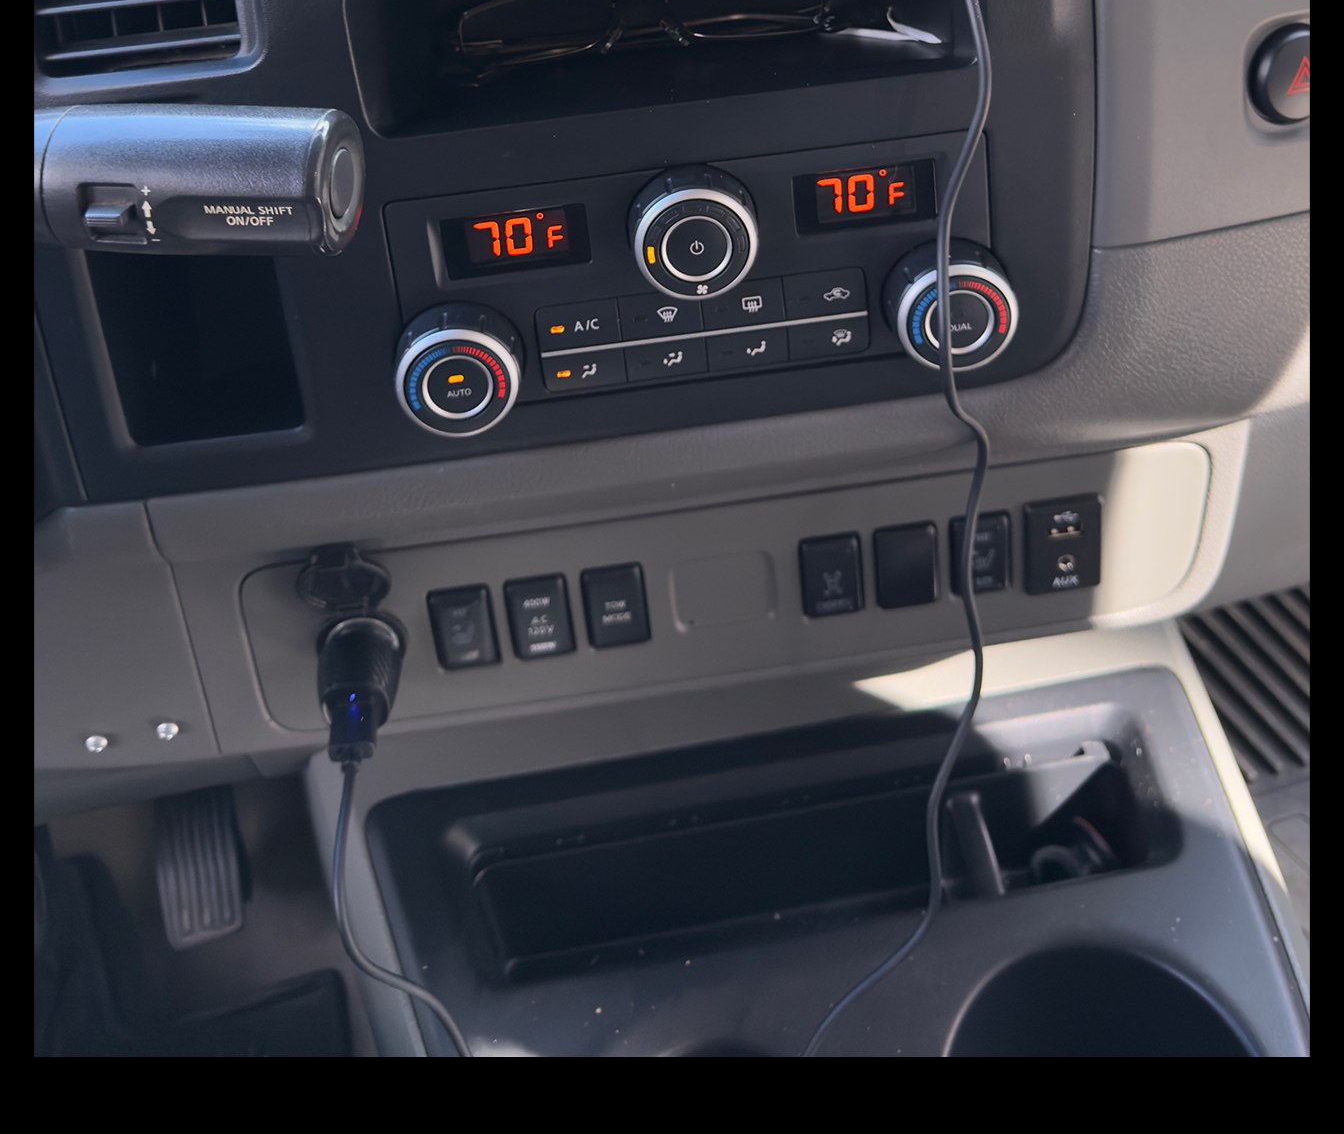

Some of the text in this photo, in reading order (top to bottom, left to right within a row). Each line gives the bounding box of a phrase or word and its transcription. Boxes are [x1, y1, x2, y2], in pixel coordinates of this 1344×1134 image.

[203, 205, 293, 215] MANUAL SHIFT
[226, 216, 274, 226] ON/OFF
[574, 318, 600, 333] A/C
[447, 387, 472, 398] AUTO
[1052, 574, 1079, 587] AUX
